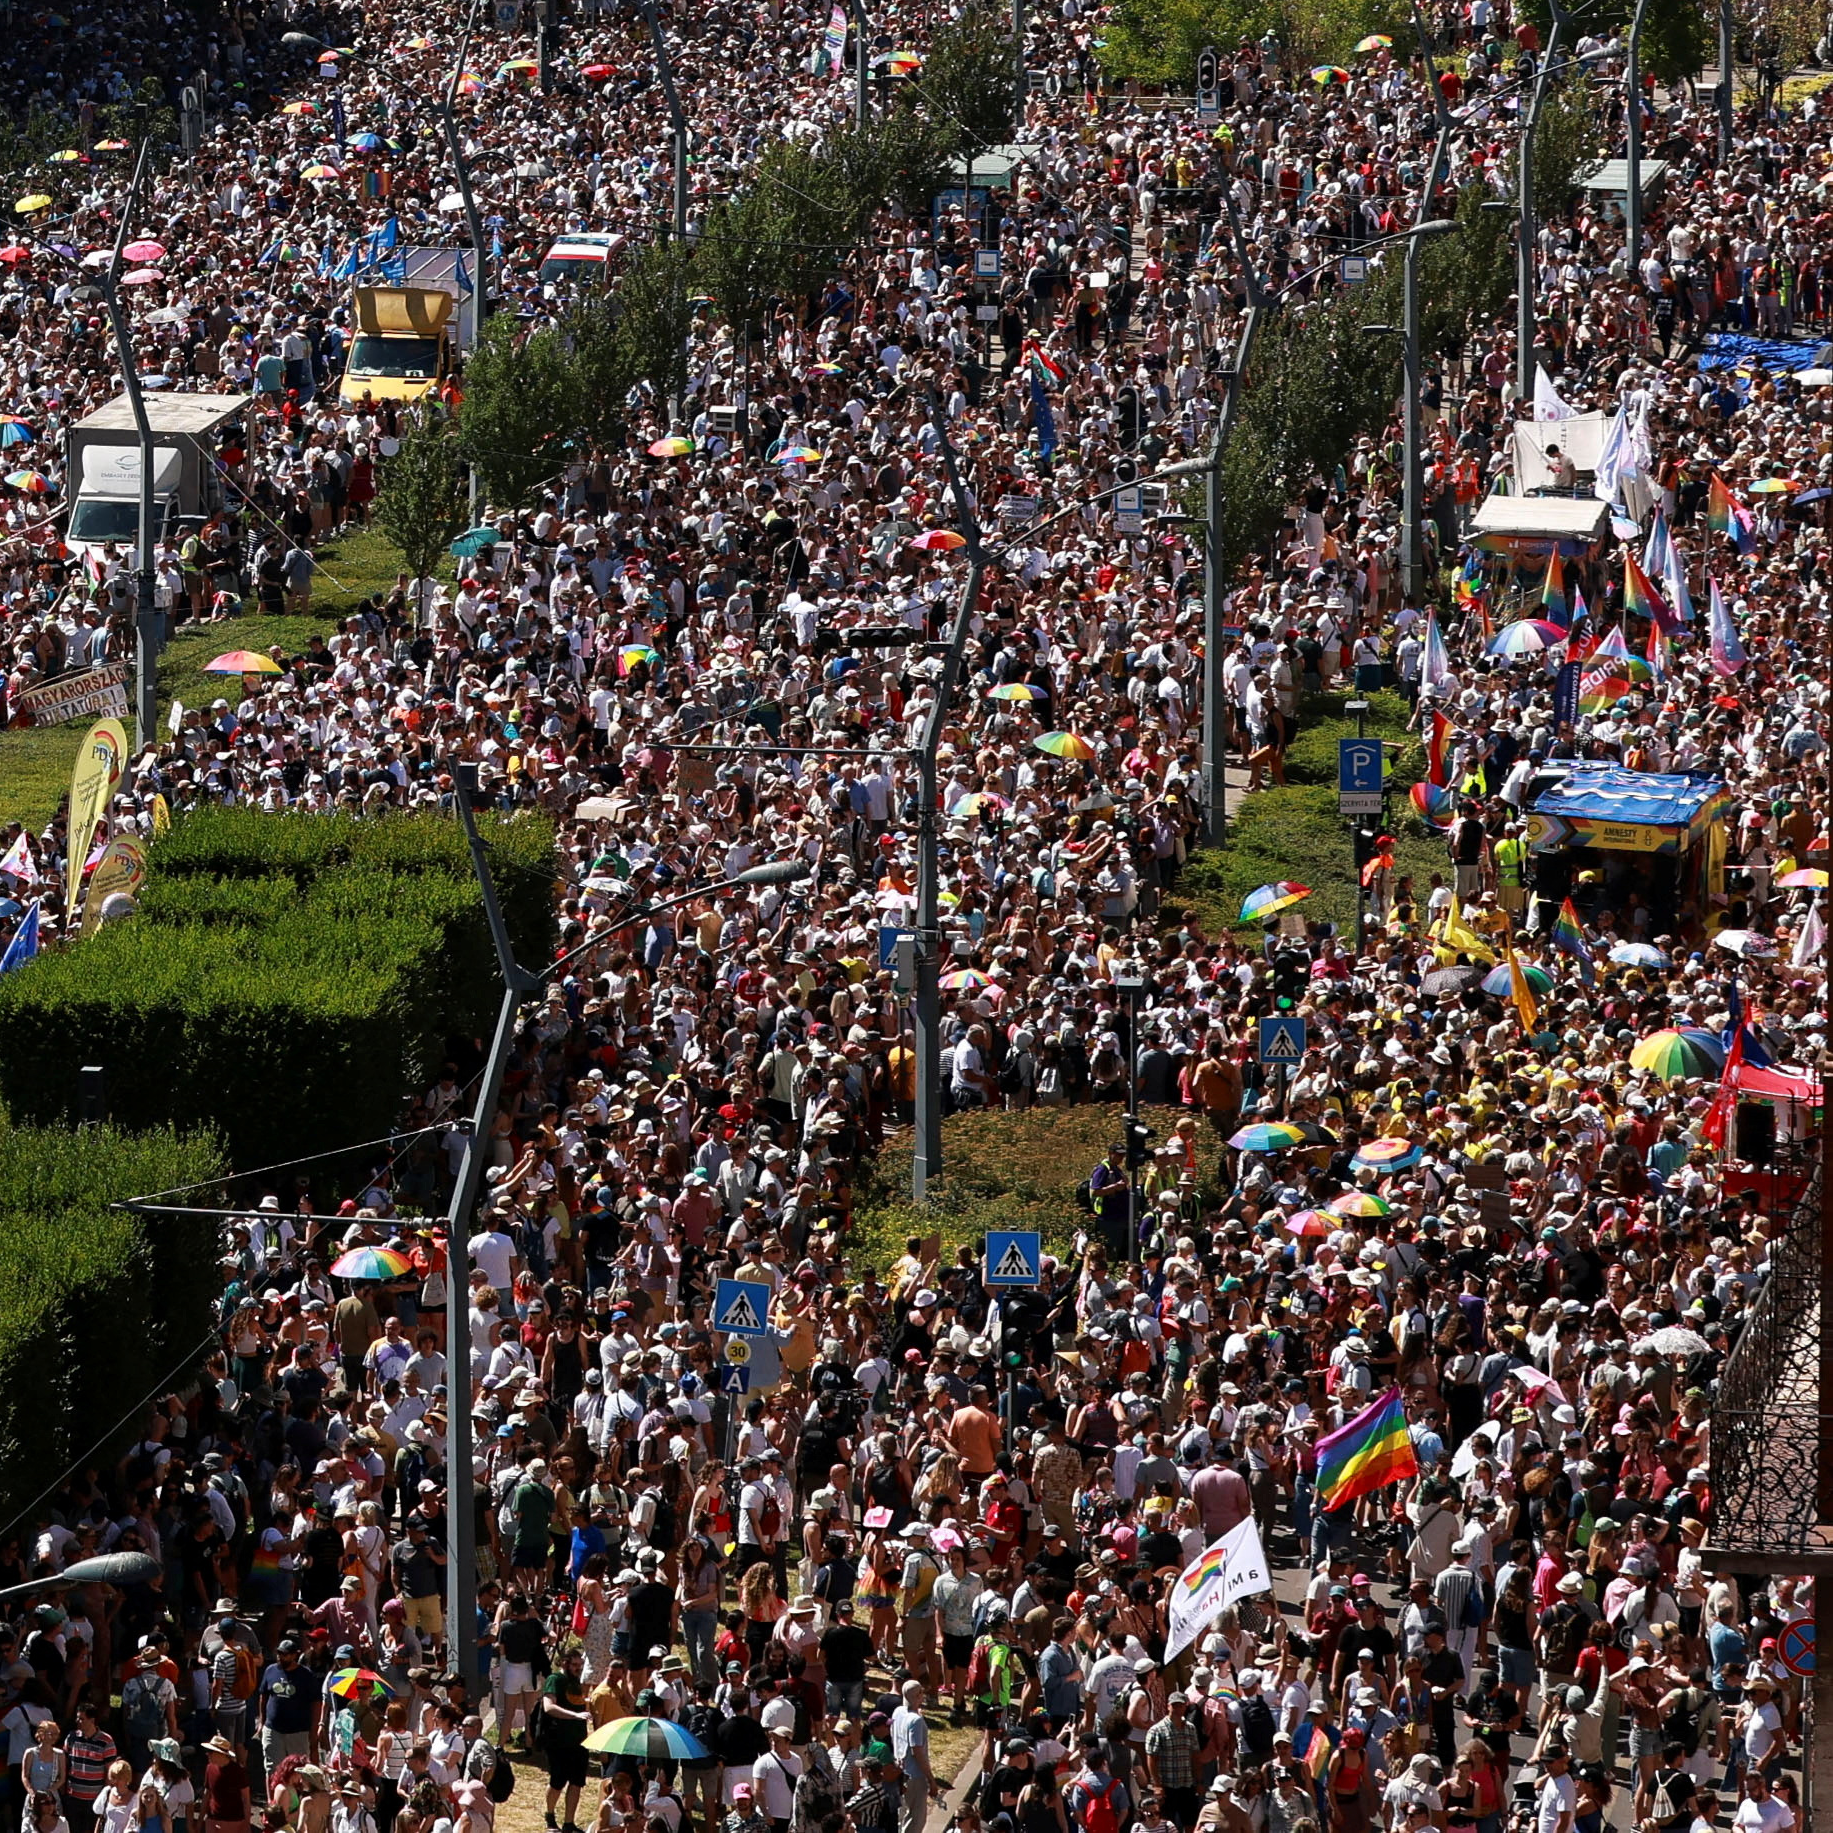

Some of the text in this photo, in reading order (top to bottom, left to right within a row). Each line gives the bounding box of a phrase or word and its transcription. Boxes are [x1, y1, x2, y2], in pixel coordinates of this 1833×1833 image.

[22, 666, 126, 713] MAGYARORSZÁG
[1353, 752, 1371, 776] P
[731, 1347, 745, 1358] 30
[725, 1367, 743, 1392] Á
